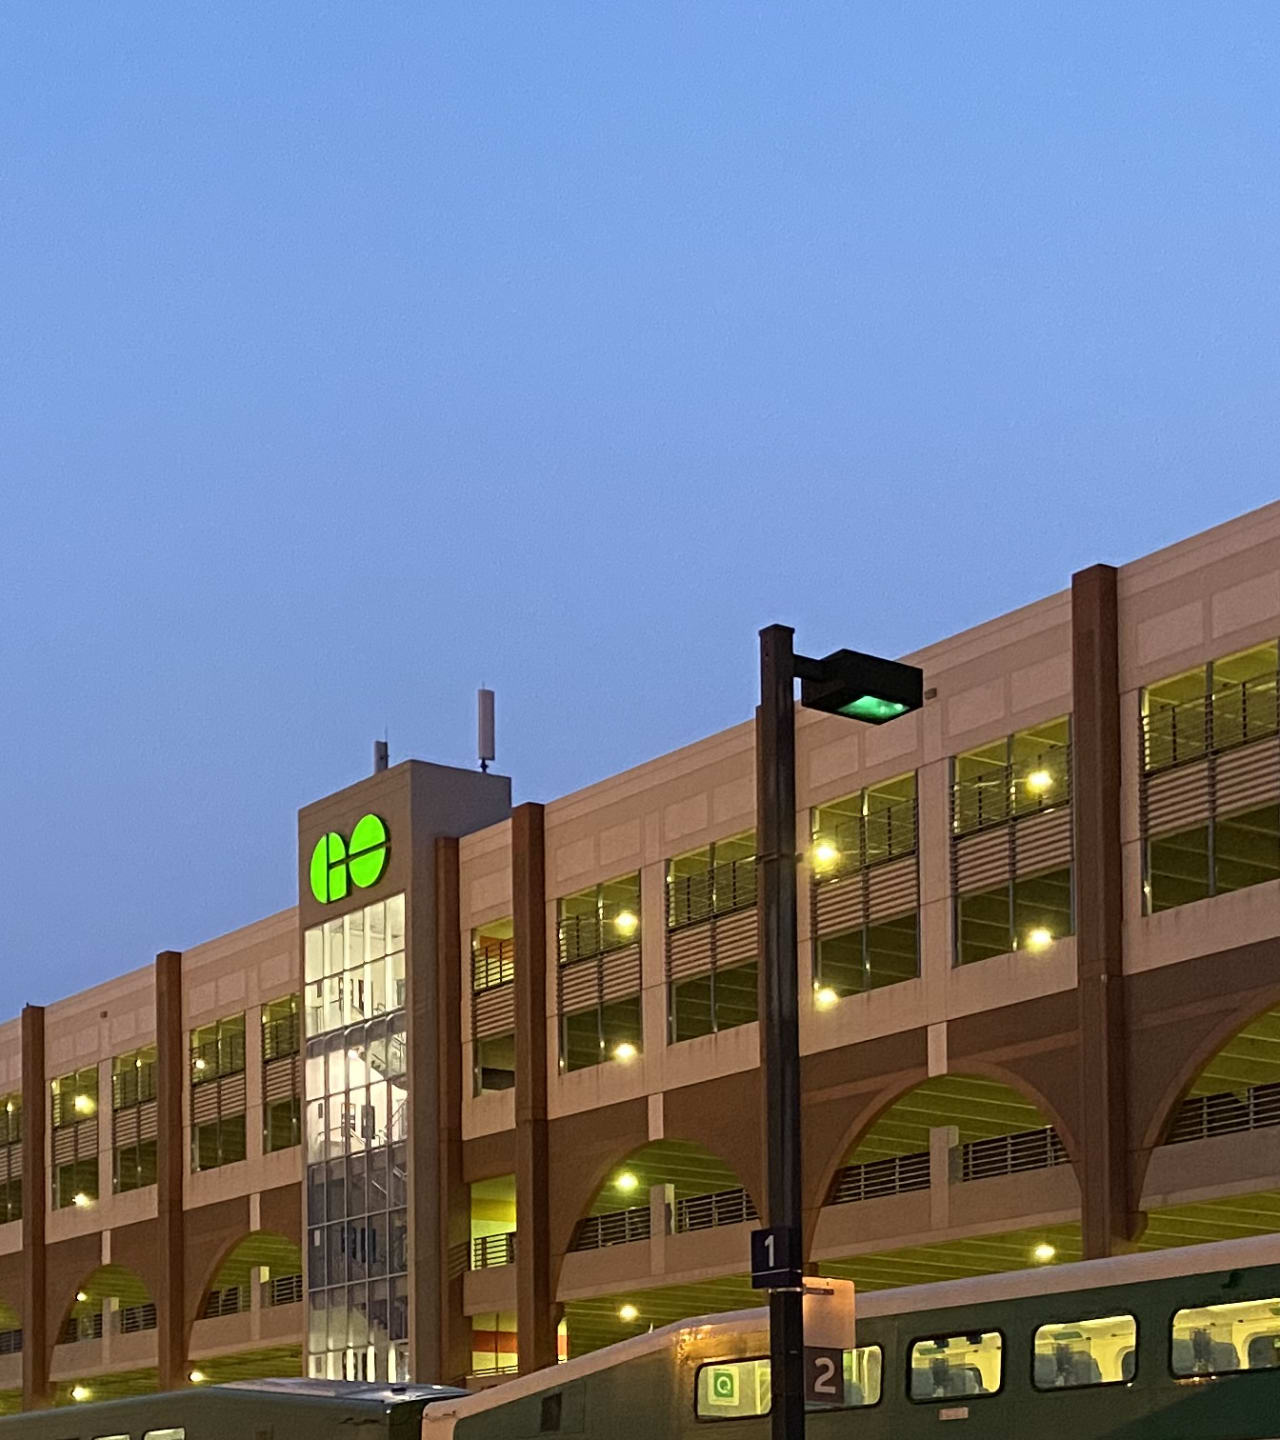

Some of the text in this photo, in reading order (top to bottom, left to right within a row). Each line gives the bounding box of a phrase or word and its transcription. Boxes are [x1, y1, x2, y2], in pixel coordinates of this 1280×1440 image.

[310, 813, 387, 904] GO
[764, 1235, 775, 1267] 1
[814, 1357, 836, 1394] 2
